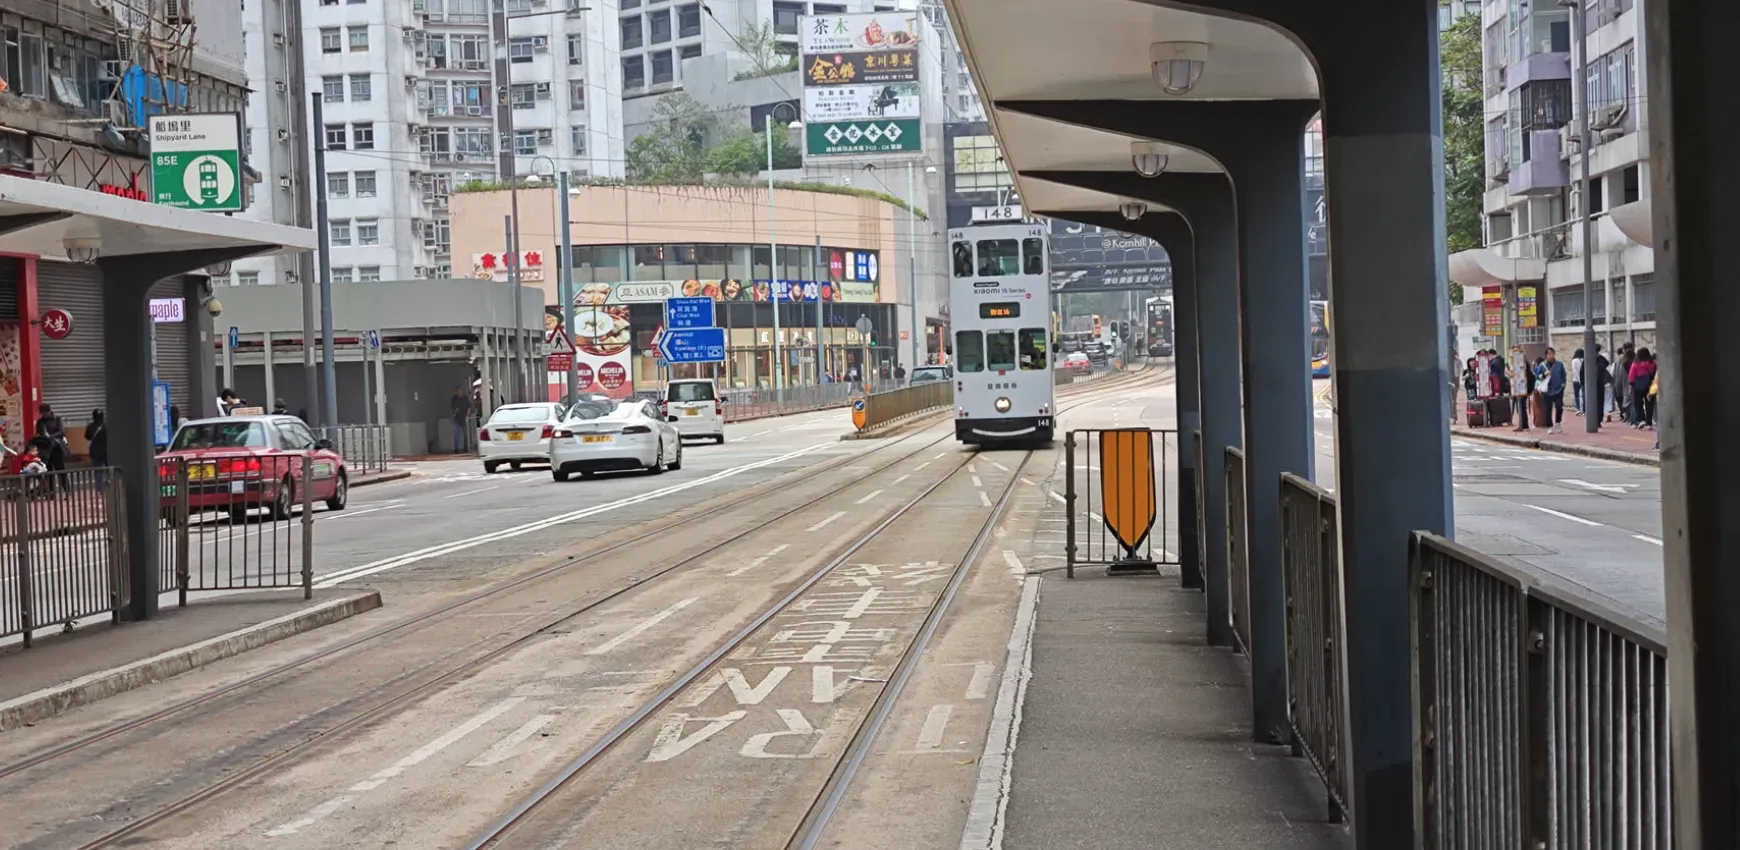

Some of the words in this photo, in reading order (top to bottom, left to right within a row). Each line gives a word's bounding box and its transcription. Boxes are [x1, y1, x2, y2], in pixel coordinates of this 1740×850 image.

[156, 120, 192, 133] 船塢里
[156, 134, 187, 142] Shipyard
[156, 155, 178, 166] 85E
[984, 206, 1013, 219] 148
[635, 286, 658, 297] ASAM
[44, 315, 67, 332] 大生
[1038, 419, 1049, 427] 148
